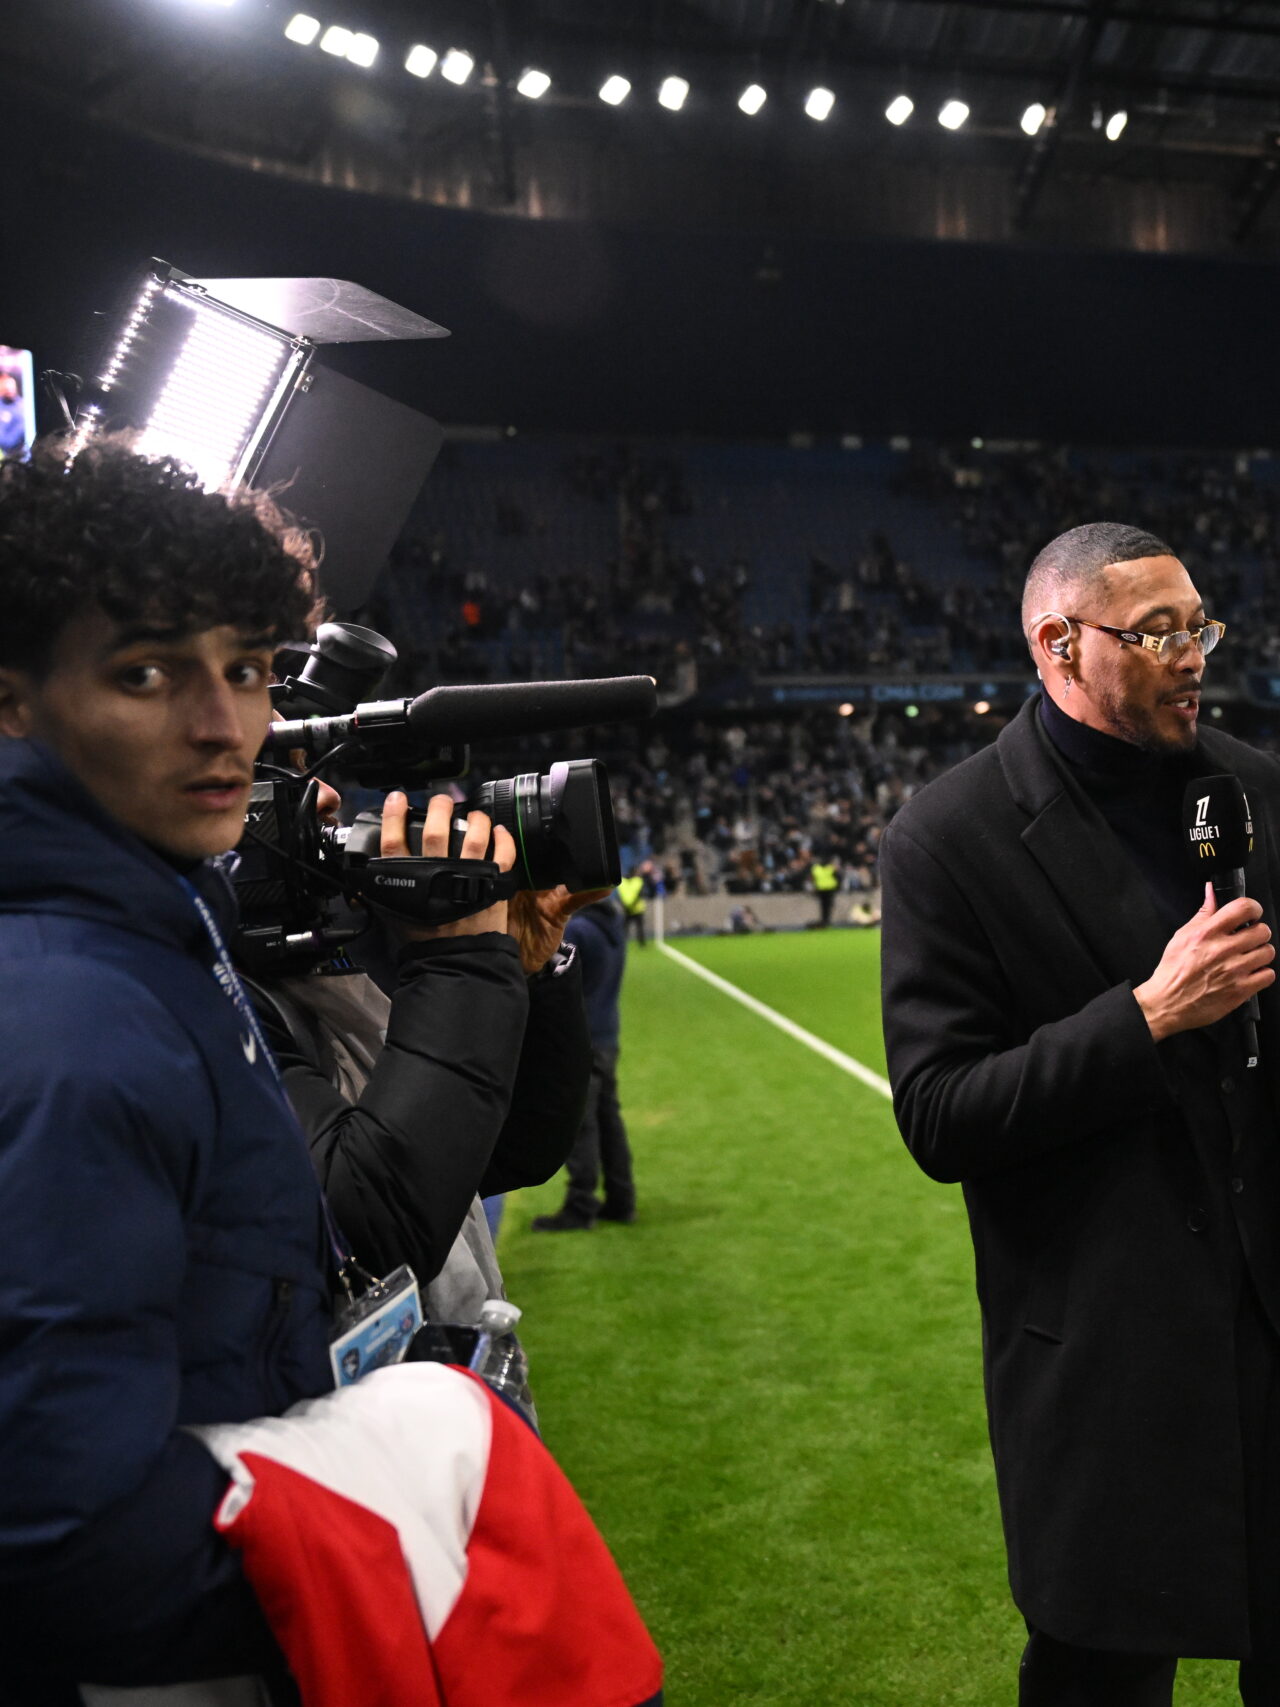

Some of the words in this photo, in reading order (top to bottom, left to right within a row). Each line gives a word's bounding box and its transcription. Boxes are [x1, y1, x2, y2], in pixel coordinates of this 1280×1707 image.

[1189, 827, 1214, 841] LIGUE
[1214, 825, 1220, 838] 1
[374, 875, 416, 888] Canon
